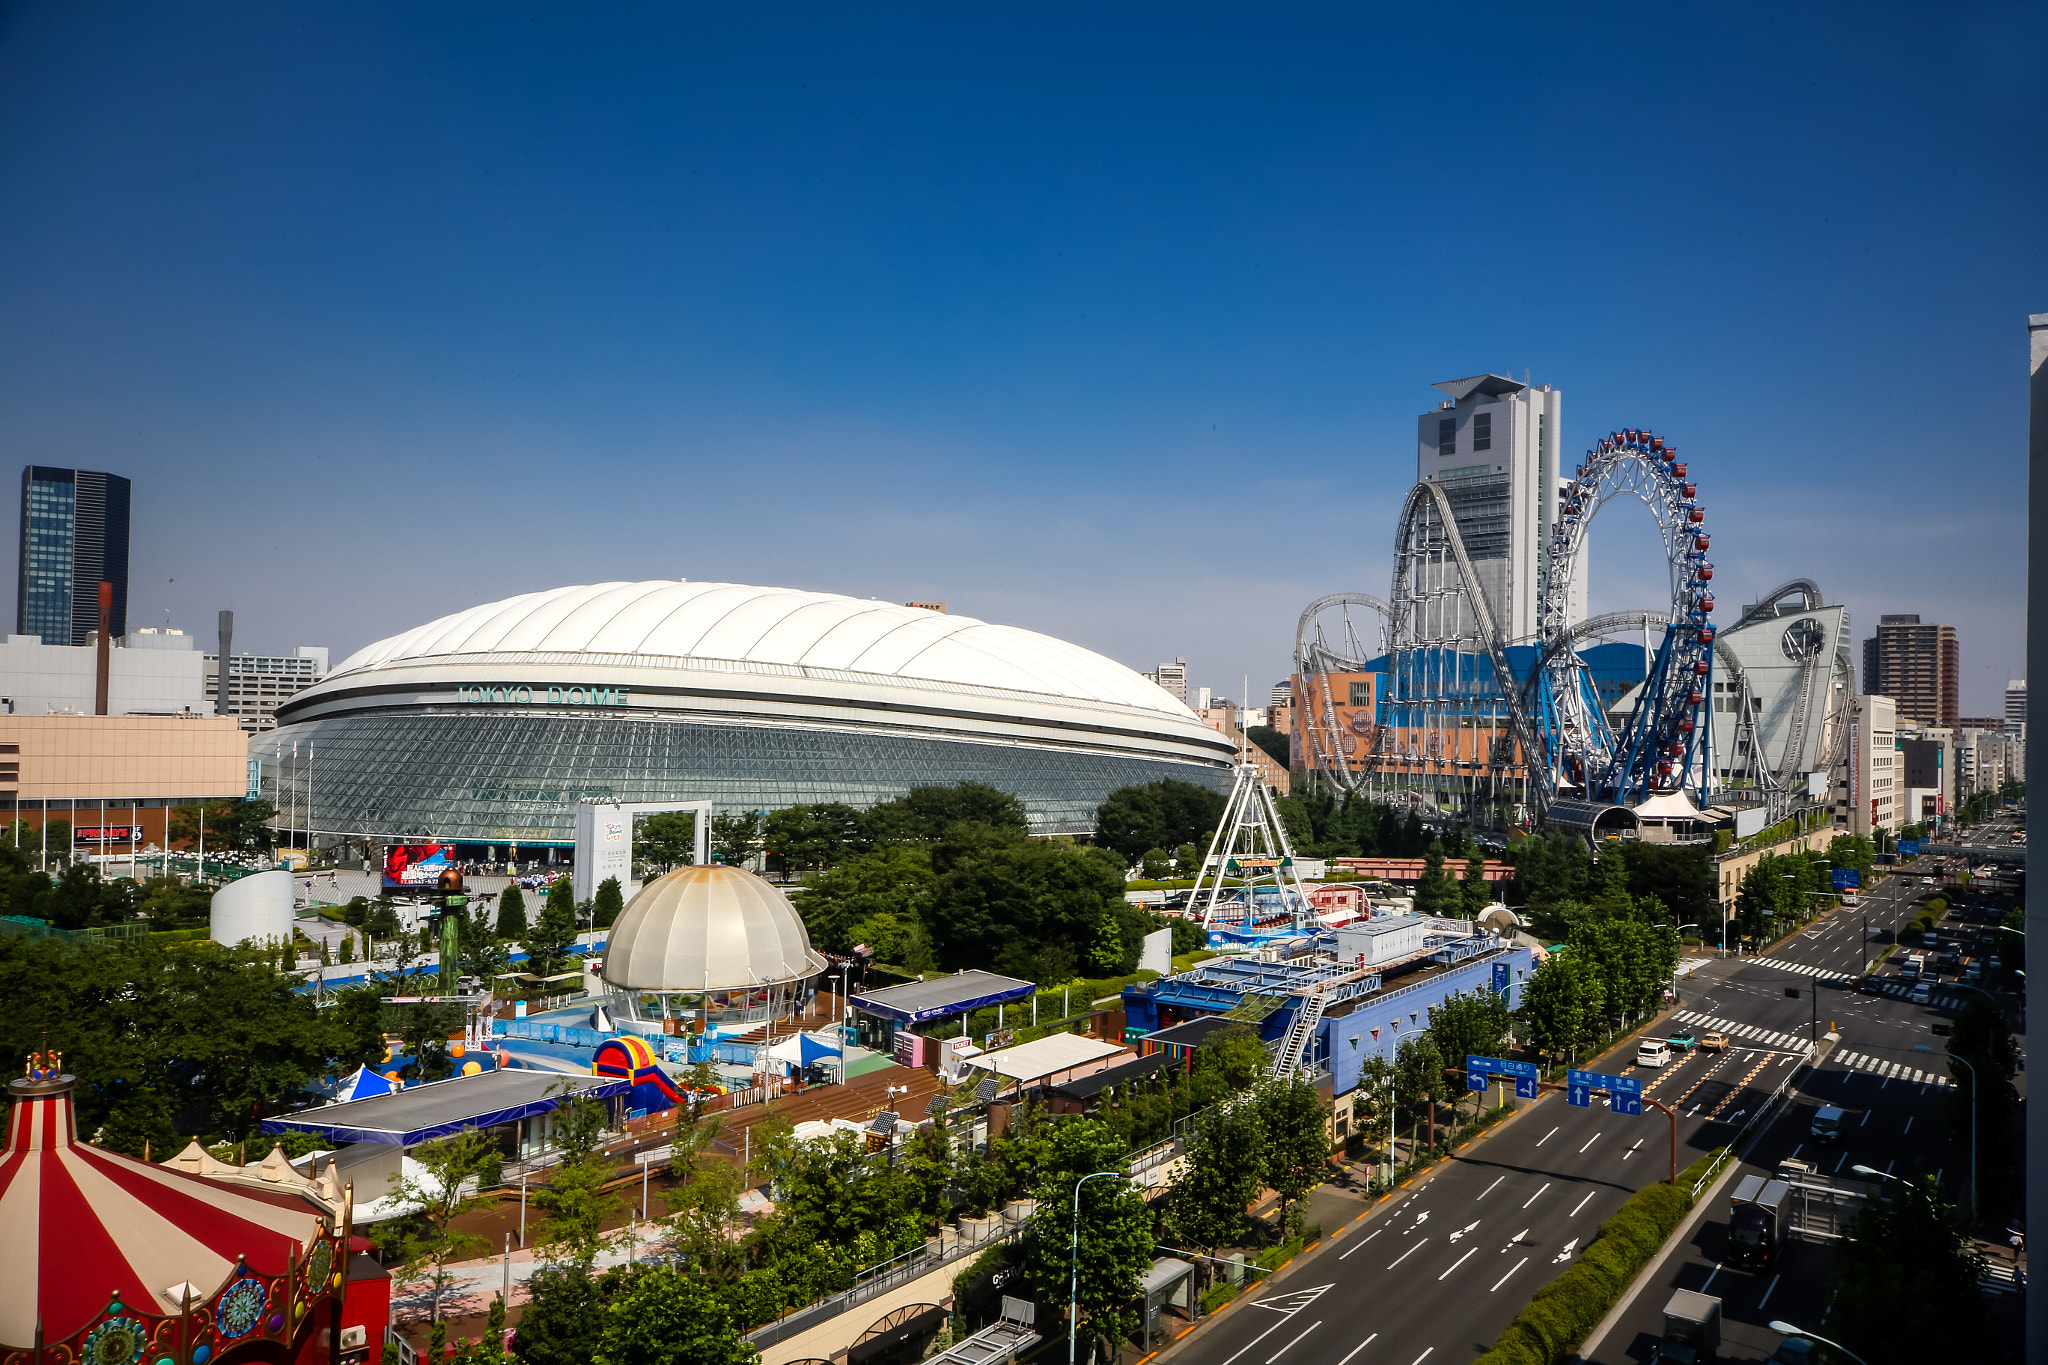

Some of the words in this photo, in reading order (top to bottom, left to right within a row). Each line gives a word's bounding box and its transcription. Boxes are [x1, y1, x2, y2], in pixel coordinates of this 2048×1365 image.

[456, 684, 533, 703] TOKYO
[548, 685, 630, 706] DOME
[954, 1040, 970, 1049] TICKET
[1500, 1060, 1530, 1072] 目白通り
